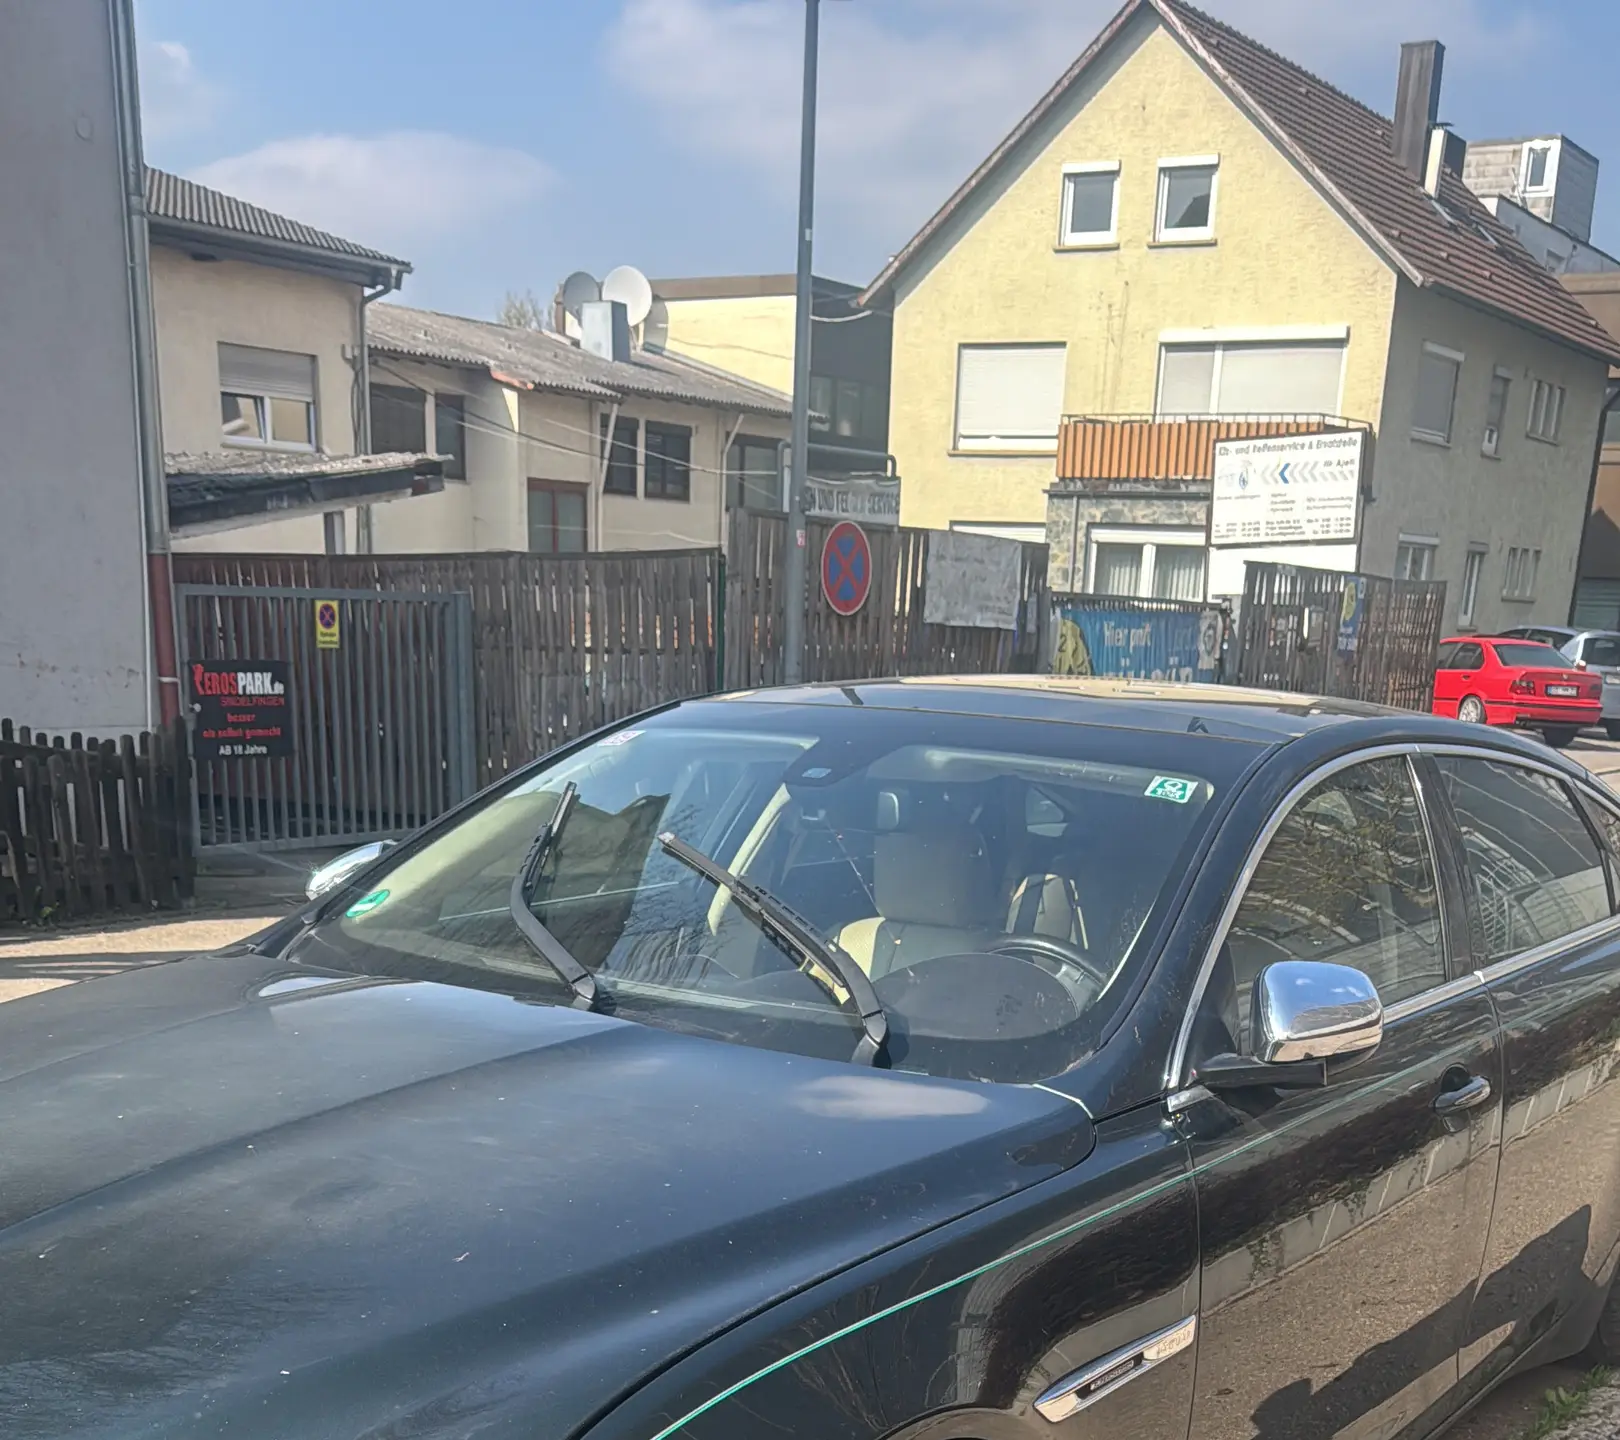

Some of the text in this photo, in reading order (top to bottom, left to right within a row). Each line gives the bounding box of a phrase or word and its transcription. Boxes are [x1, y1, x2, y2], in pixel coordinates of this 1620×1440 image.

[1103, 620, 1128, 647] Hier
[219, 744, 268, 756] AB 18 Jahre
